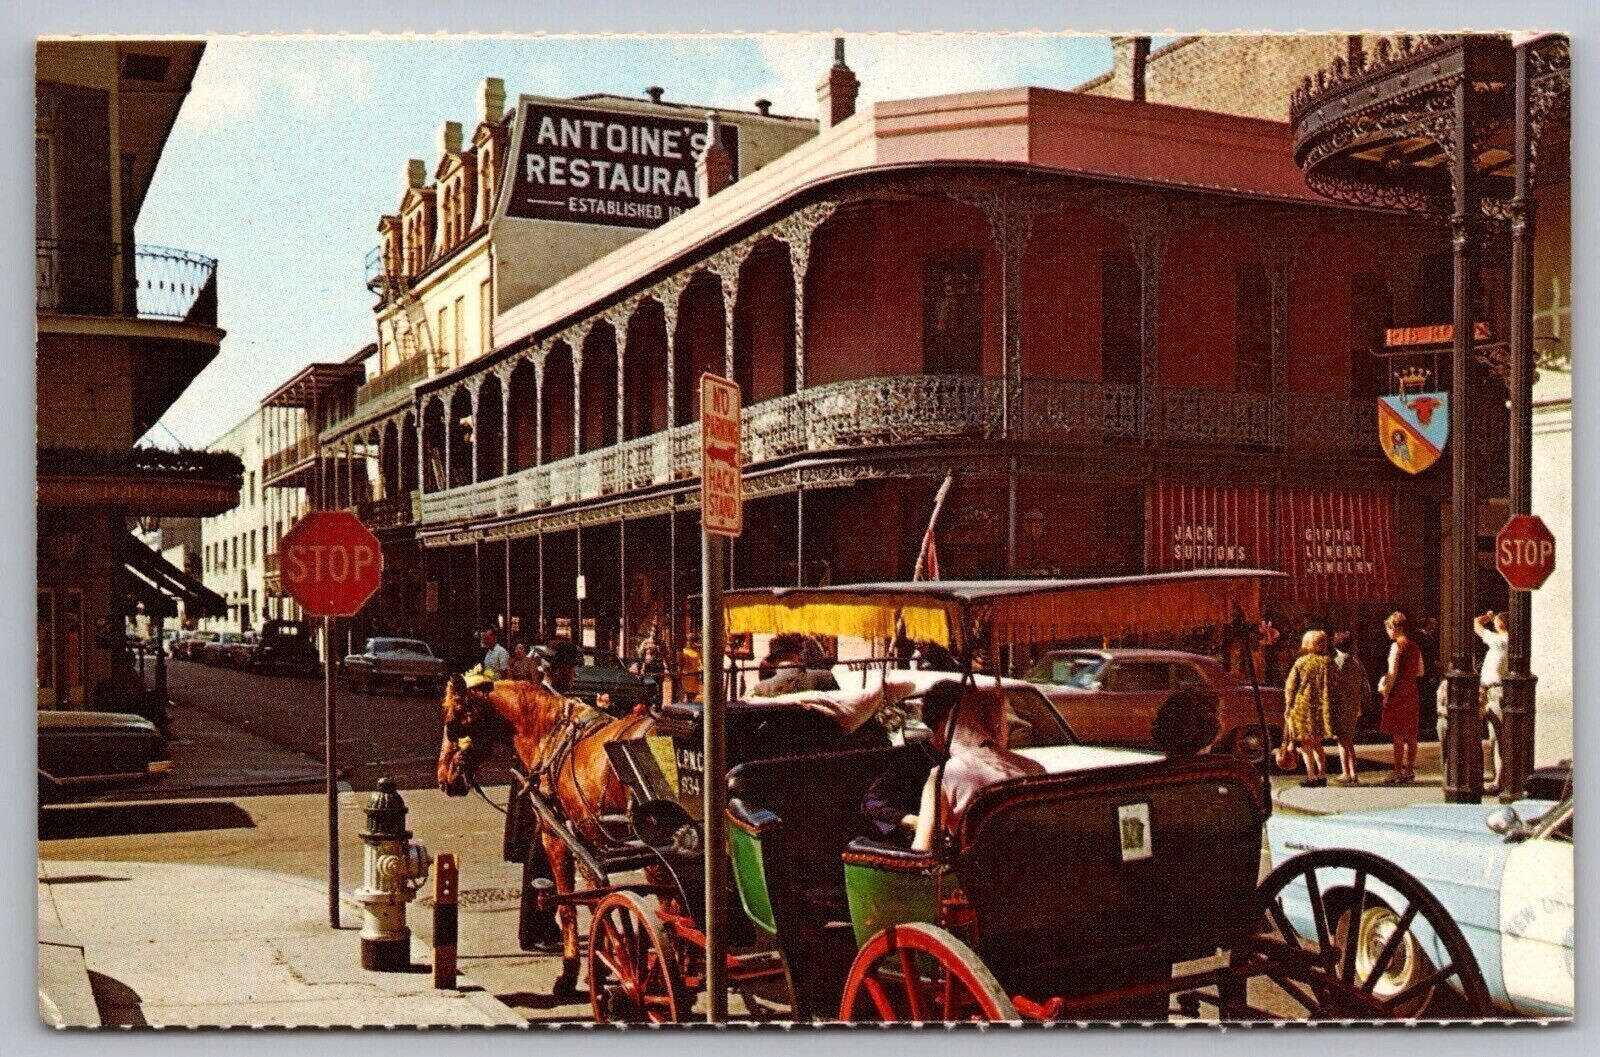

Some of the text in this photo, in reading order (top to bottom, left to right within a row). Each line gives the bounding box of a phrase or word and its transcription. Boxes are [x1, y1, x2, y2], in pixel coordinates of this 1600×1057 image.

[537, 116, 708, 161] ANTOINE'S
[569, 197, 690, 222] ESTABLISHED 18
[712, 385, 730, 415] NO
[709, 467, 736, 495] HACK
[709, 493, 737, 519] STAND
[1174, 526, 1215, 542] JACK
[1305, 528, 1352, 543] GIFTS
[288, 545, 374, 583] STOP
[1174, 545, 1246, 561] SUTTONS
[1306, 544, 1363, 559] LINENS
[1501, 539, 1553, 567] STOP
[1306, 560, 1374, 575] JEWELRY
